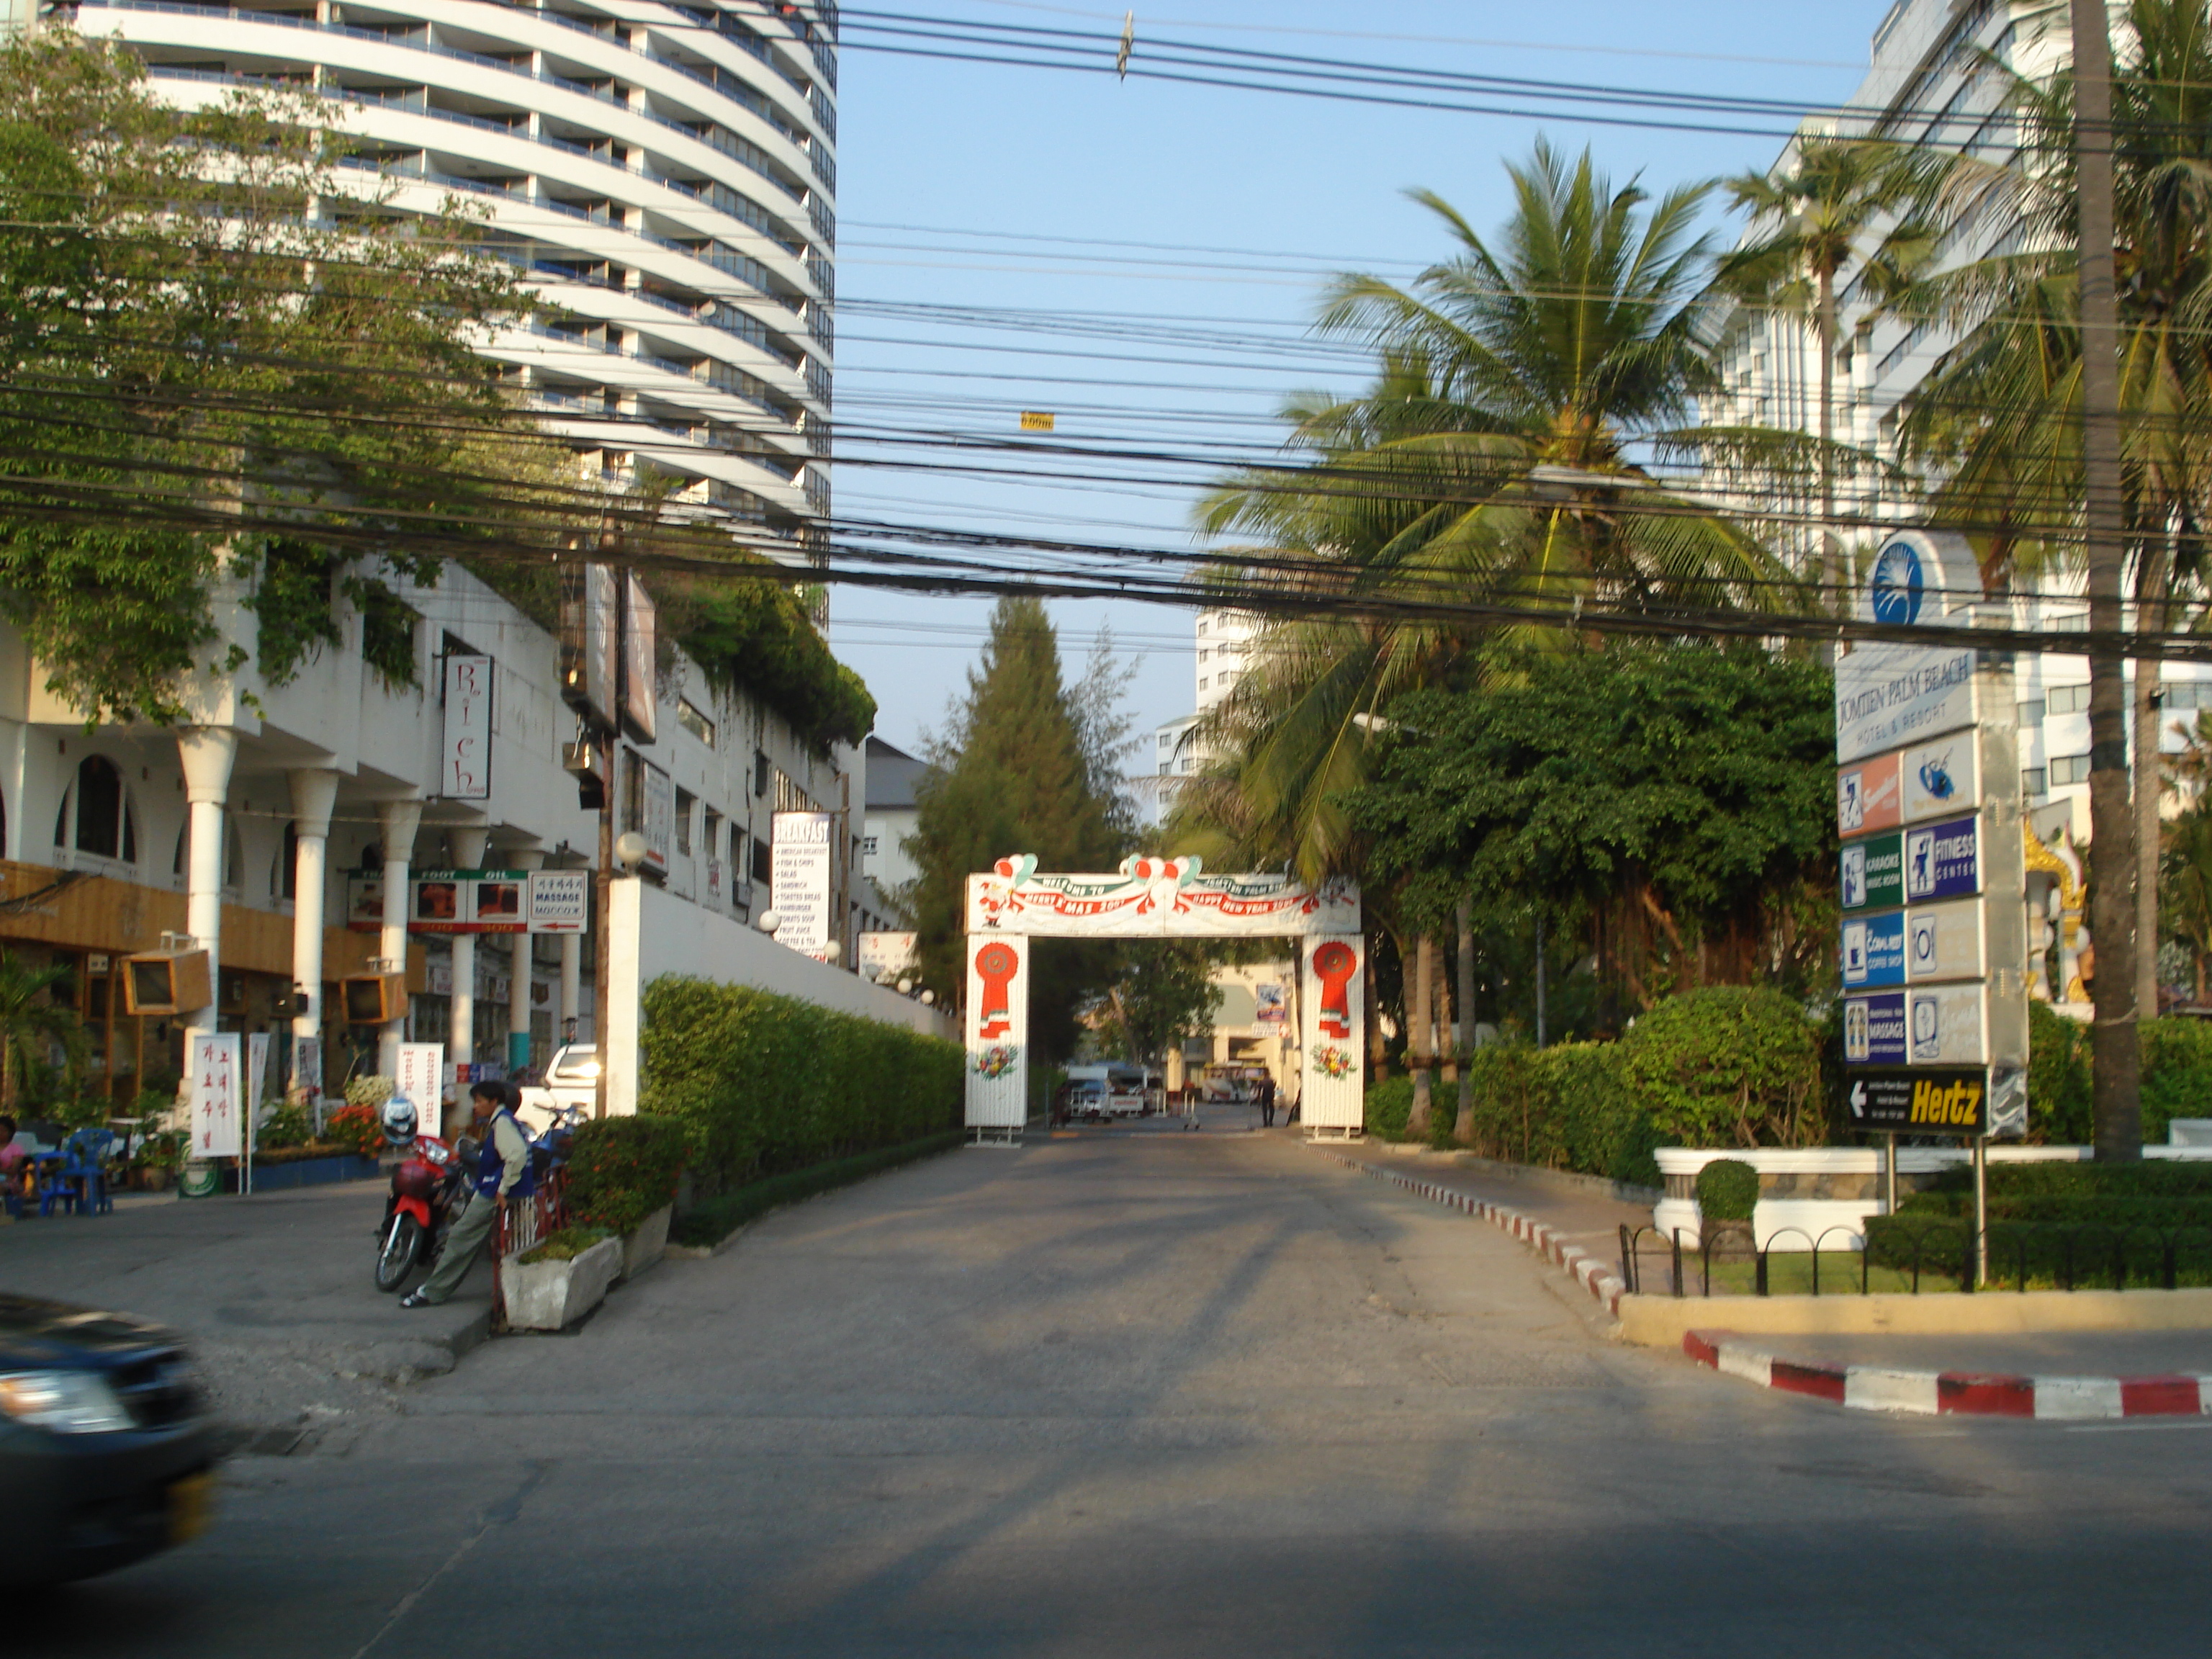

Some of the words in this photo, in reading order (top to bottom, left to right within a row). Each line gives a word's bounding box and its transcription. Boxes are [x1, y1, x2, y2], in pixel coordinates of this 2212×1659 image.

[1839, 685, 1884, 730] JOMTIEN
[1888, 671, 1920, 707] PALM
[1925, 653, 1968, 694] BEACH
[1857, 723, 1887, 747] HOTEL
[1903, 703, 1946, 729] RESORT
[774, 821, 829, 843] BREAKFAST
[1935, 832, 1975, 863] FITNESS
[485, 870, 509, 880] OIL
[1936, 860, 1974, 881] CENTER
[1043, 877, 1086, 896] WELCOME
[1091, 885, 1105, 896] TO
[1245, 885, 1267, 895] PALM
[536, 893, 579, 903] MASSAGE
[1025, 893, 1057, 907] MERRY
[1192, 894, 1223, 906] HAPPY
[1223, 900, 1245, 914] NEW
[1246, 902, 1269, 914] YEAR
[1869, 1021, 1905, 1039] MASSAGE
[1910, 1079, 1981, 1125] Hertz
